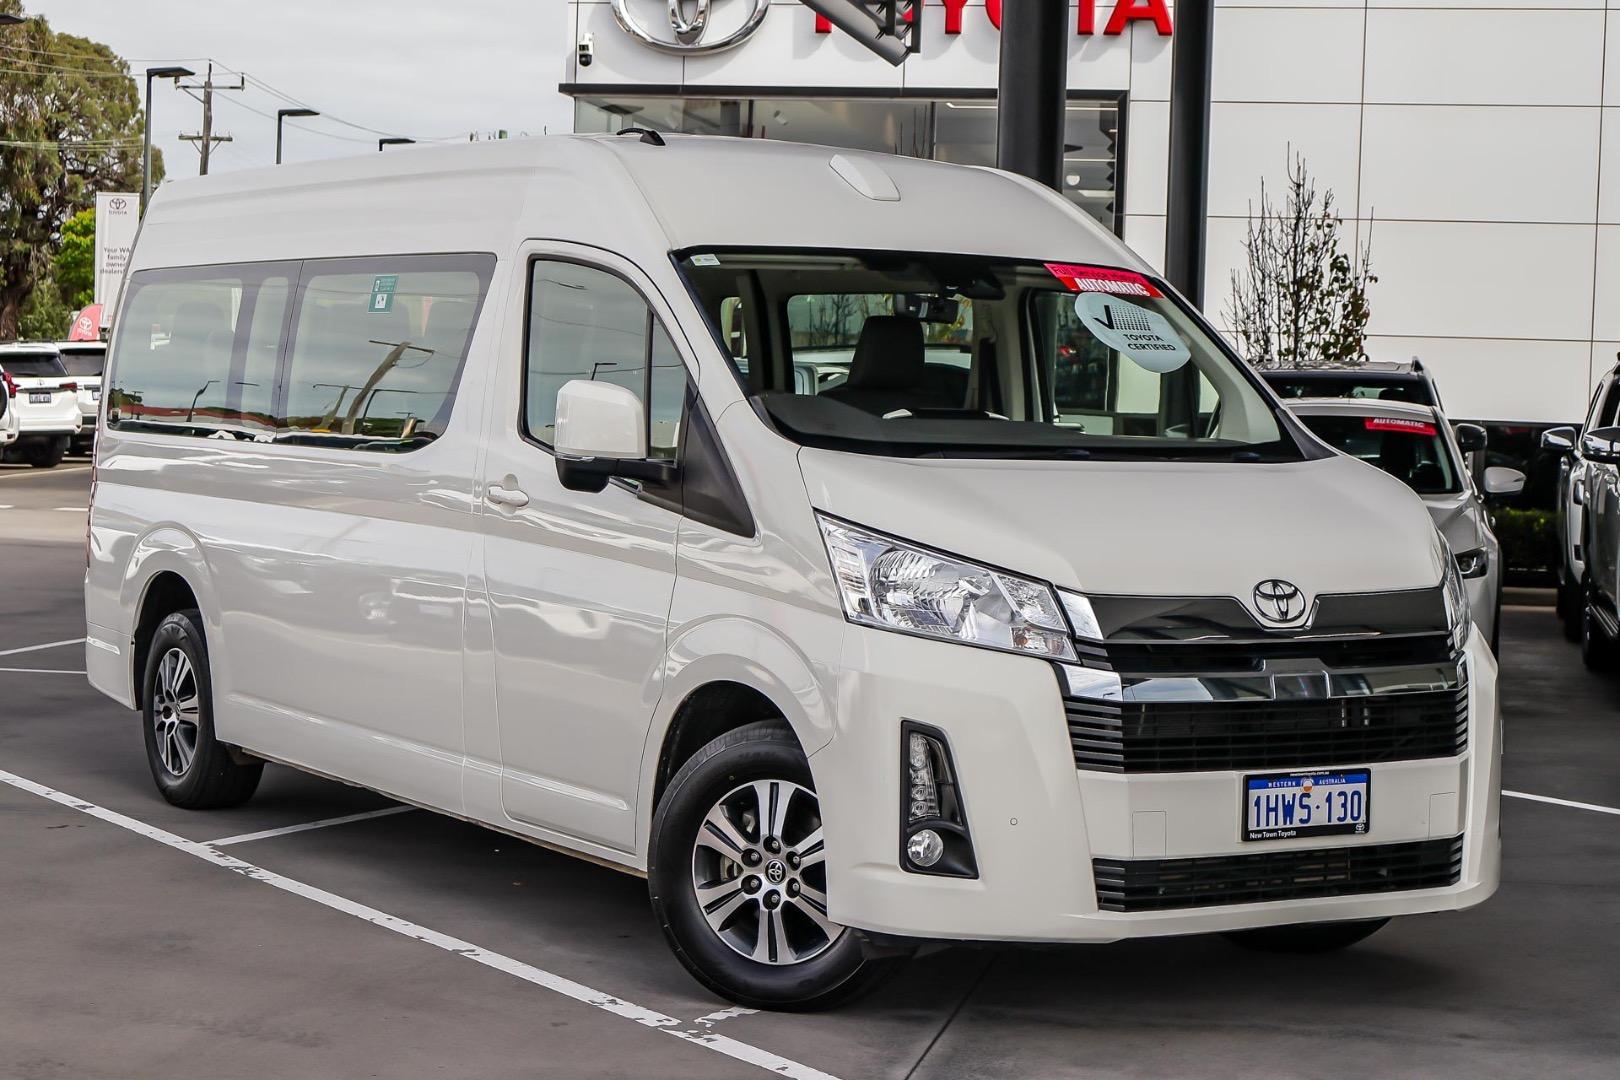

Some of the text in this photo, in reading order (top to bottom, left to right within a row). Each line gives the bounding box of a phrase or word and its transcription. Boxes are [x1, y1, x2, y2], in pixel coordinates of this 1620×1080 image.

[815, 0, 1173, 36] YTA
[1074, 277, 1151, 297] AUTOMATIC
[1122, 333, 1164, 342] TOYOTA
[1127, 343, 1177, 351] CERTIFIED
[1373, 418, 1426, 428] AUTOMATIC
